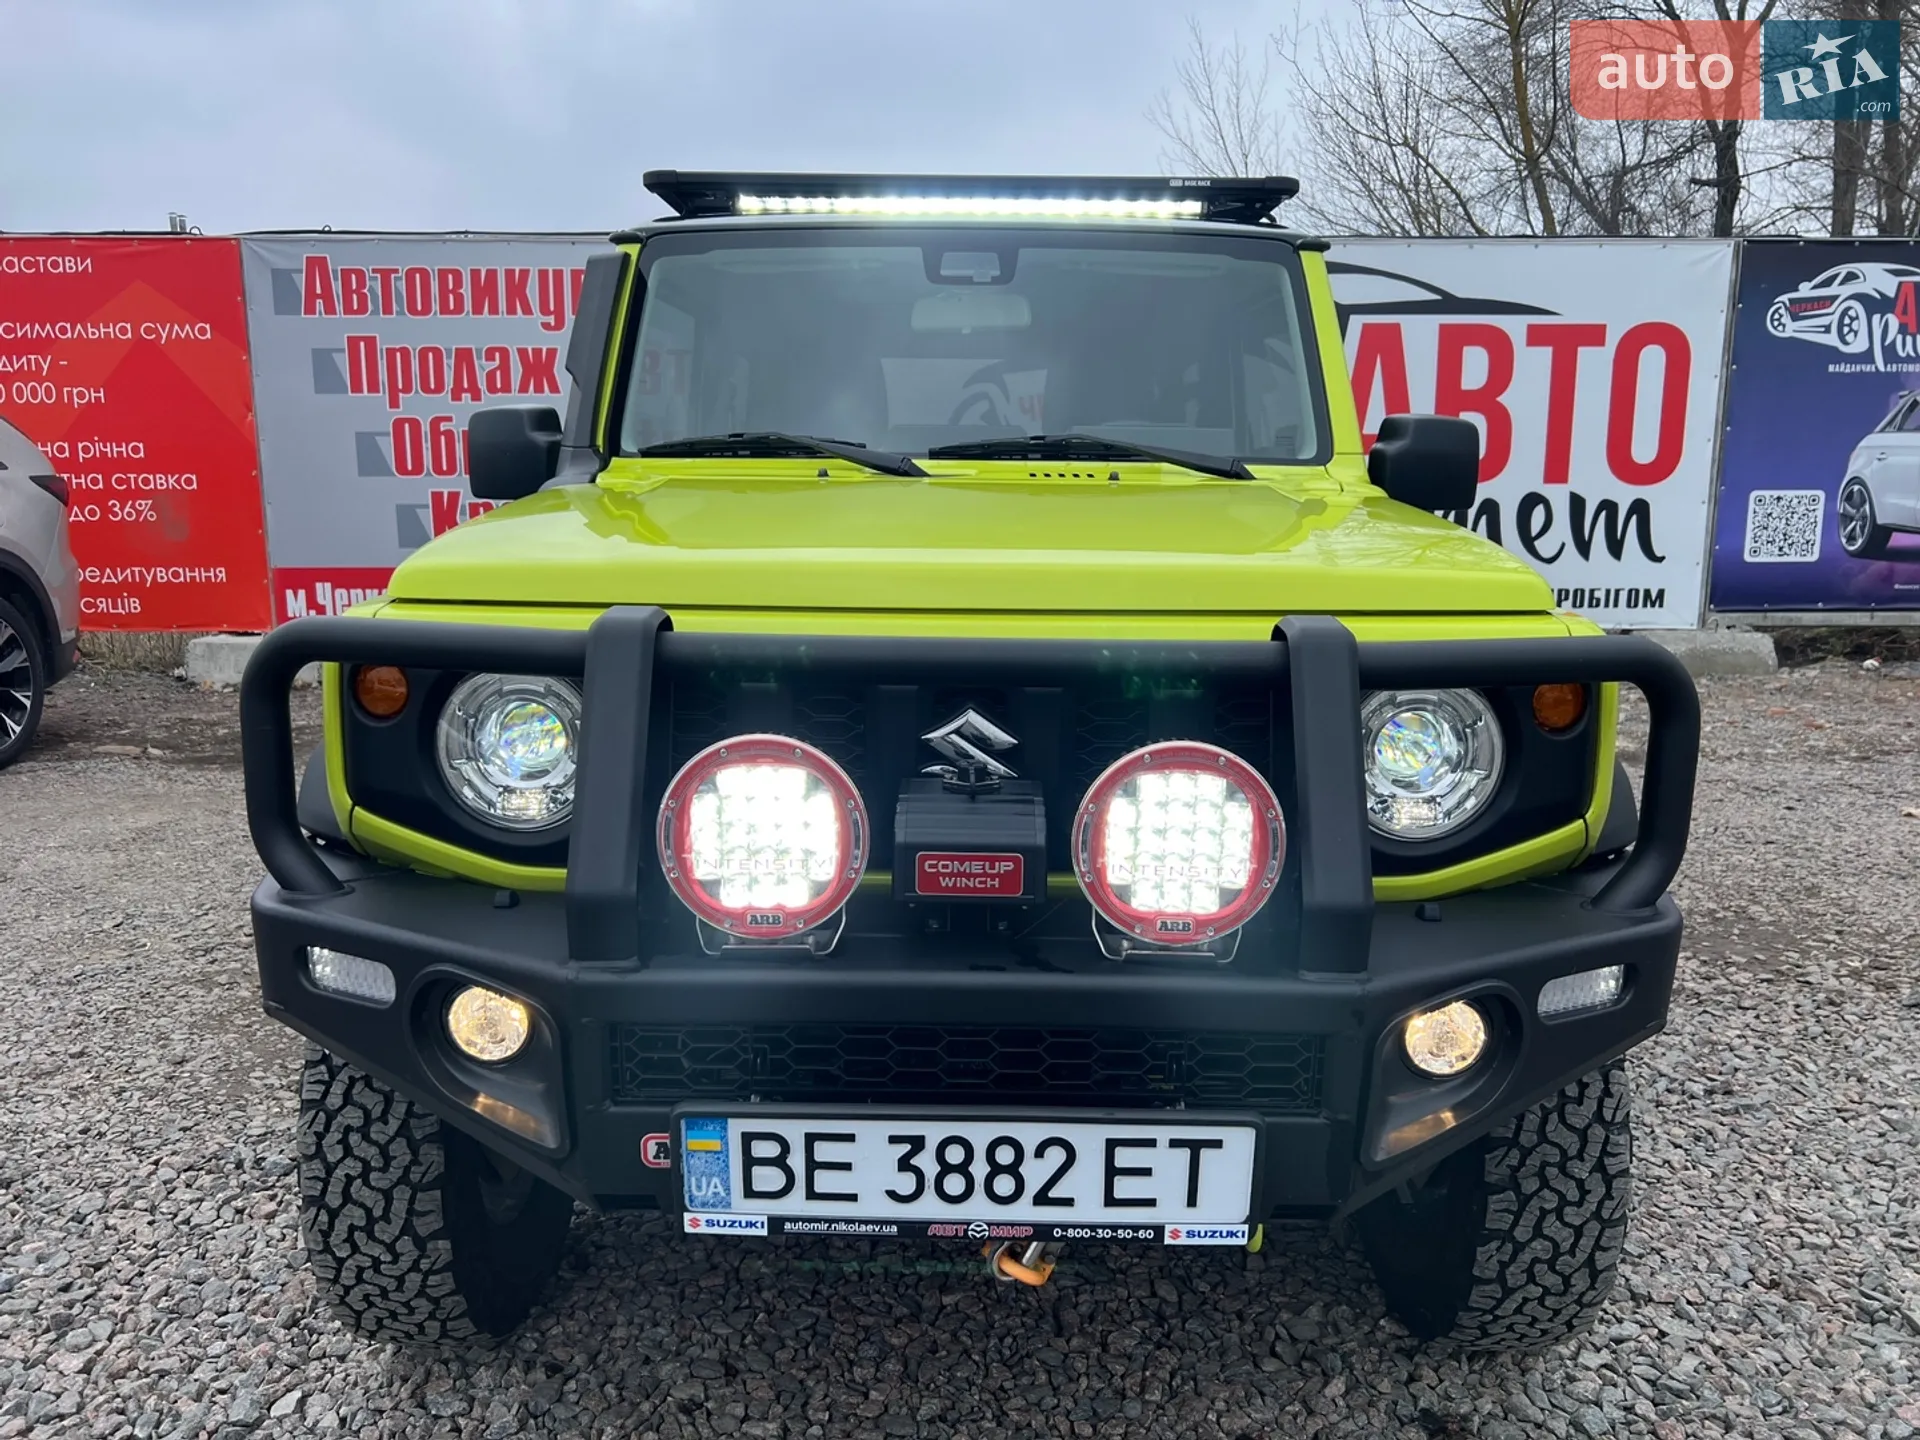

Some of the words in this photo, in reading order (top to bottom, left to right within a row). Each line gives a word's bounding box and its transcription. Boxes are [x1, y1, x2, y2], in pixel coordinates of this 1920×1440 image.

[0, 255, 92, 274] астави
[0, 322, 132, 340] симальна
[140, 322, 212, 344] сума
[1872, 313, 1920, 372] Ри
[345, 335, 563, 411] Продаж
[12, 381, 56, 404] 000
[63, 386, 105, 408] грн
[1351, 320, 1692, 487] АВТО
[77, 436, 145, 463] річна
[56, 473, 104, 490] тна
[111, 473, 198, 490] ставка
[69, 504, 100, 522] до
[108, 500, 157, 522] 36%
[80, 592, 142, 615] сяців
[1550, 588, 1666, 609] РОБІГОМ
[924, 860, 1015, 874] COMEUP
[938, 876, 999, 889] WINCH
[749, 914, 782, 926] ARB
[1157, 921, 1192, 933] ARB
[740, 1131, 860, 1203] BE
[884, 1134, 1077, 1207] 3882
[1103, 1137, 1224, 1208] ET
[691, 1175, 727, 1198] UA
[705, 1219, 765, 1230] SUZUKI
[784, 1220, 898, 1235] automir.nikolaev.ua
[1053, 1227, 1155, 1240] 0-800-30-50-60
[1185, 1229, 1247, 1240] SUZUKI
